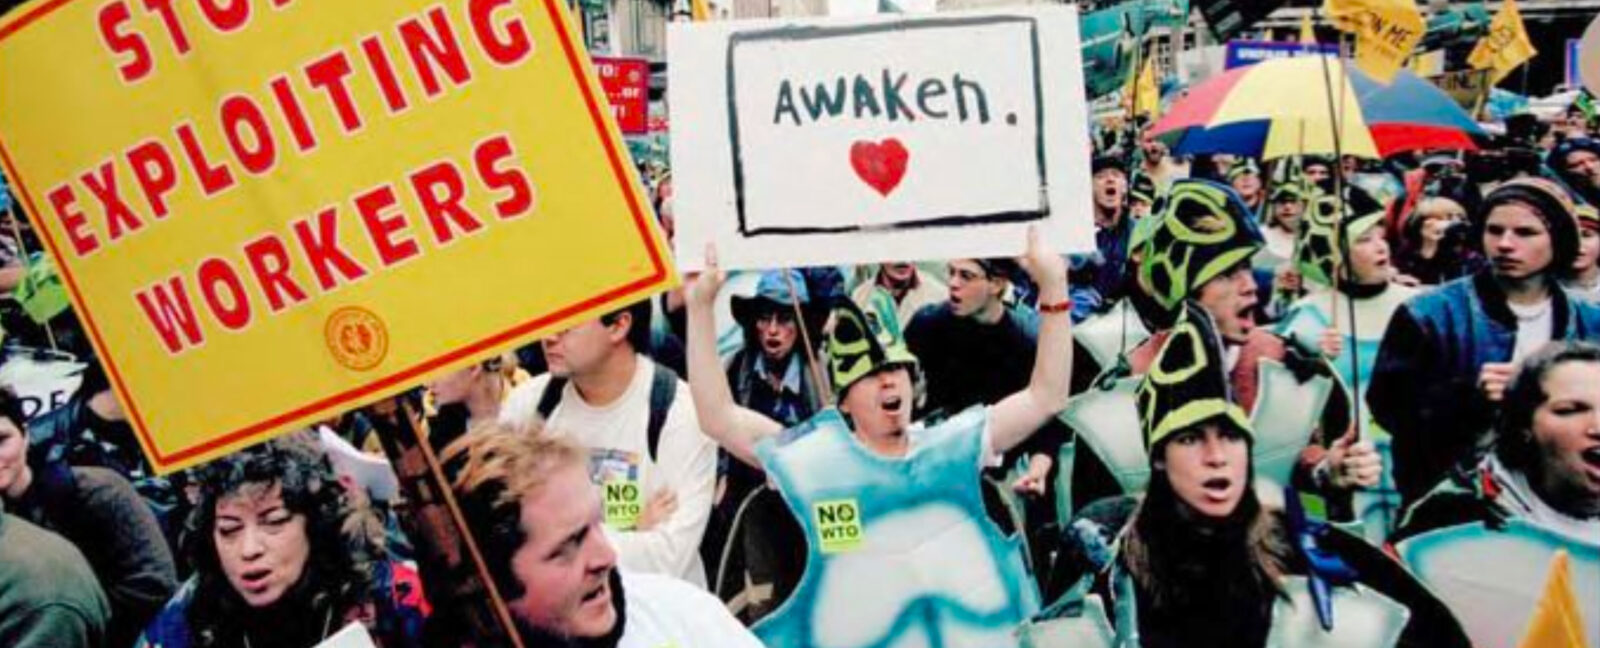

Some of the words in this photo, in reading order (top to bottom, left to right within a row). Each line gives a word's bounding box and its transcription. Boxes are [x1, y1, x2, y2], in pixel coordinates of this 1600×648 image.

[98, 0, 291, 82] ST
[46, 0, 532, 258] EXPLOITING
[135, 135, 535, 355] WORKERS
[606, 484, 639, 502] NO
[817, 503, 855, 524] NO
[821, 525, 859, 540] WTO
